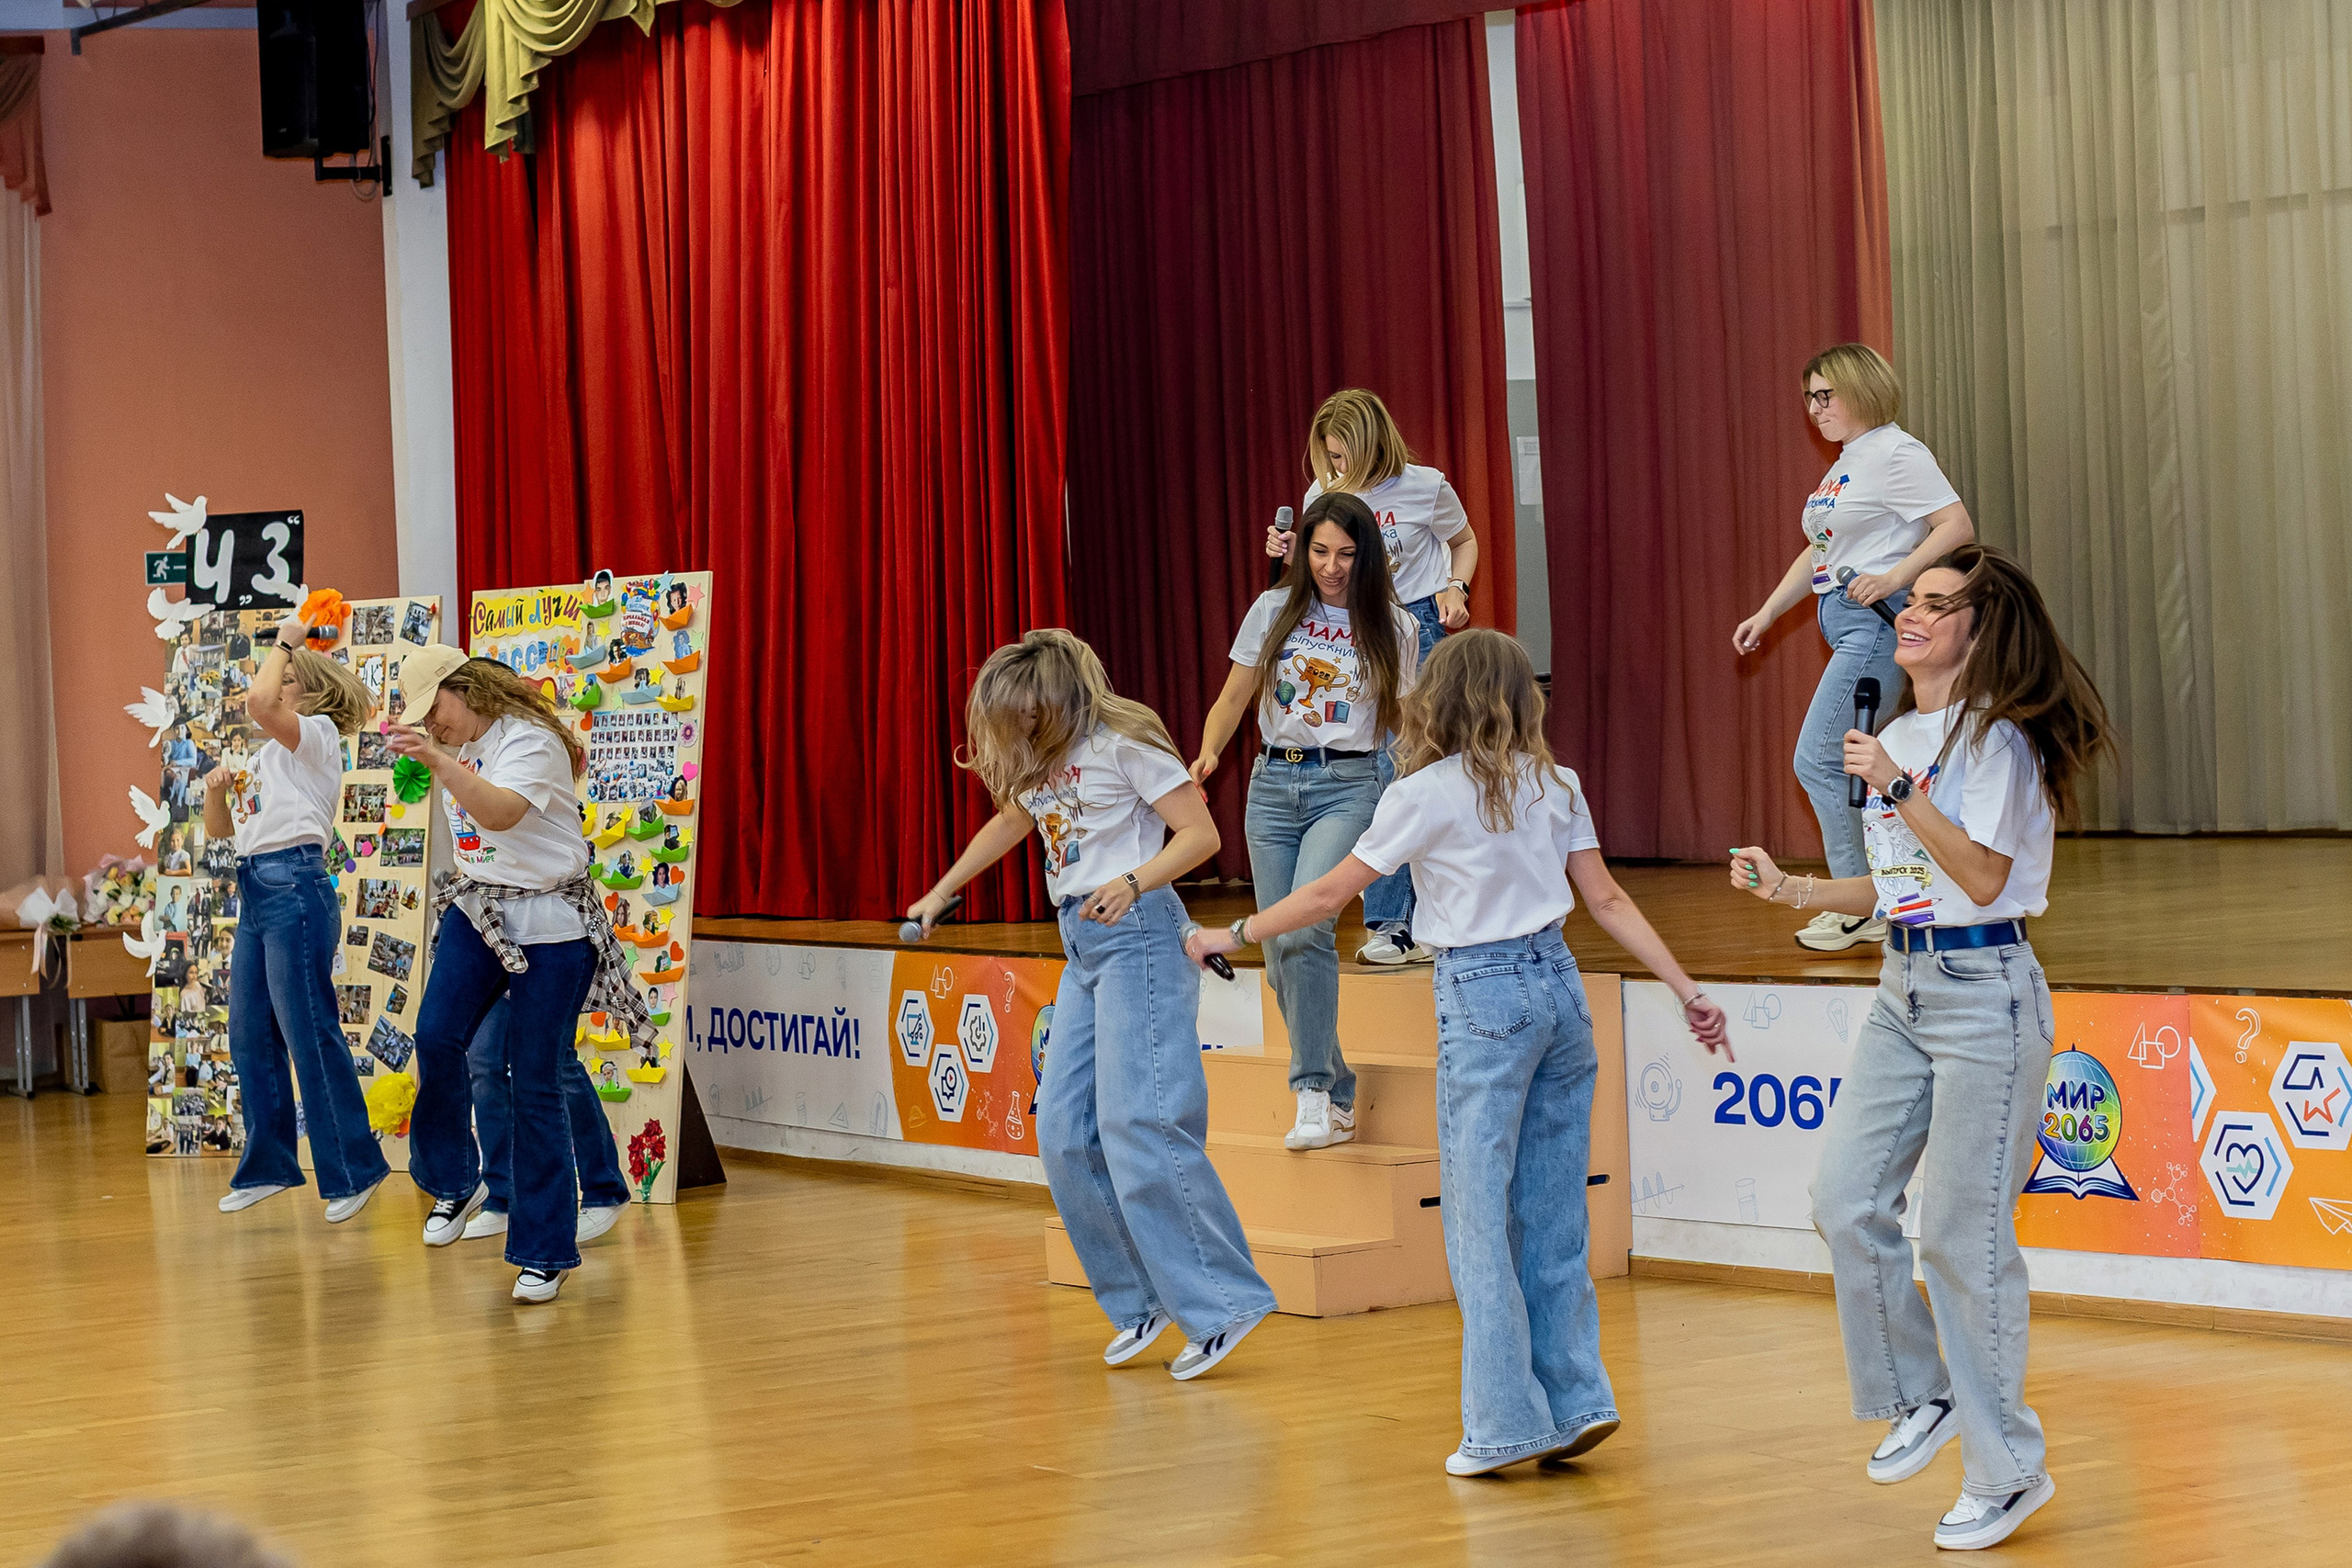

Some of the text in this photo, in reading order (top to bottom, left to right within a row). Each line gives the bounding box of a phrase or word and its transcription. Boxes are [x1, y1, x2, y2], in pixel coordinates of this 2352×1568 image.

[528, 594, 584, 626] лучш
[1307, 666, 1331, 681] 2025
[707, 1006, 862, 1060] ДОСТИГАЙ!
[2045, 1079, 2107, 1113] МИР
[2042, 1111, 2111, 1144] 2065
